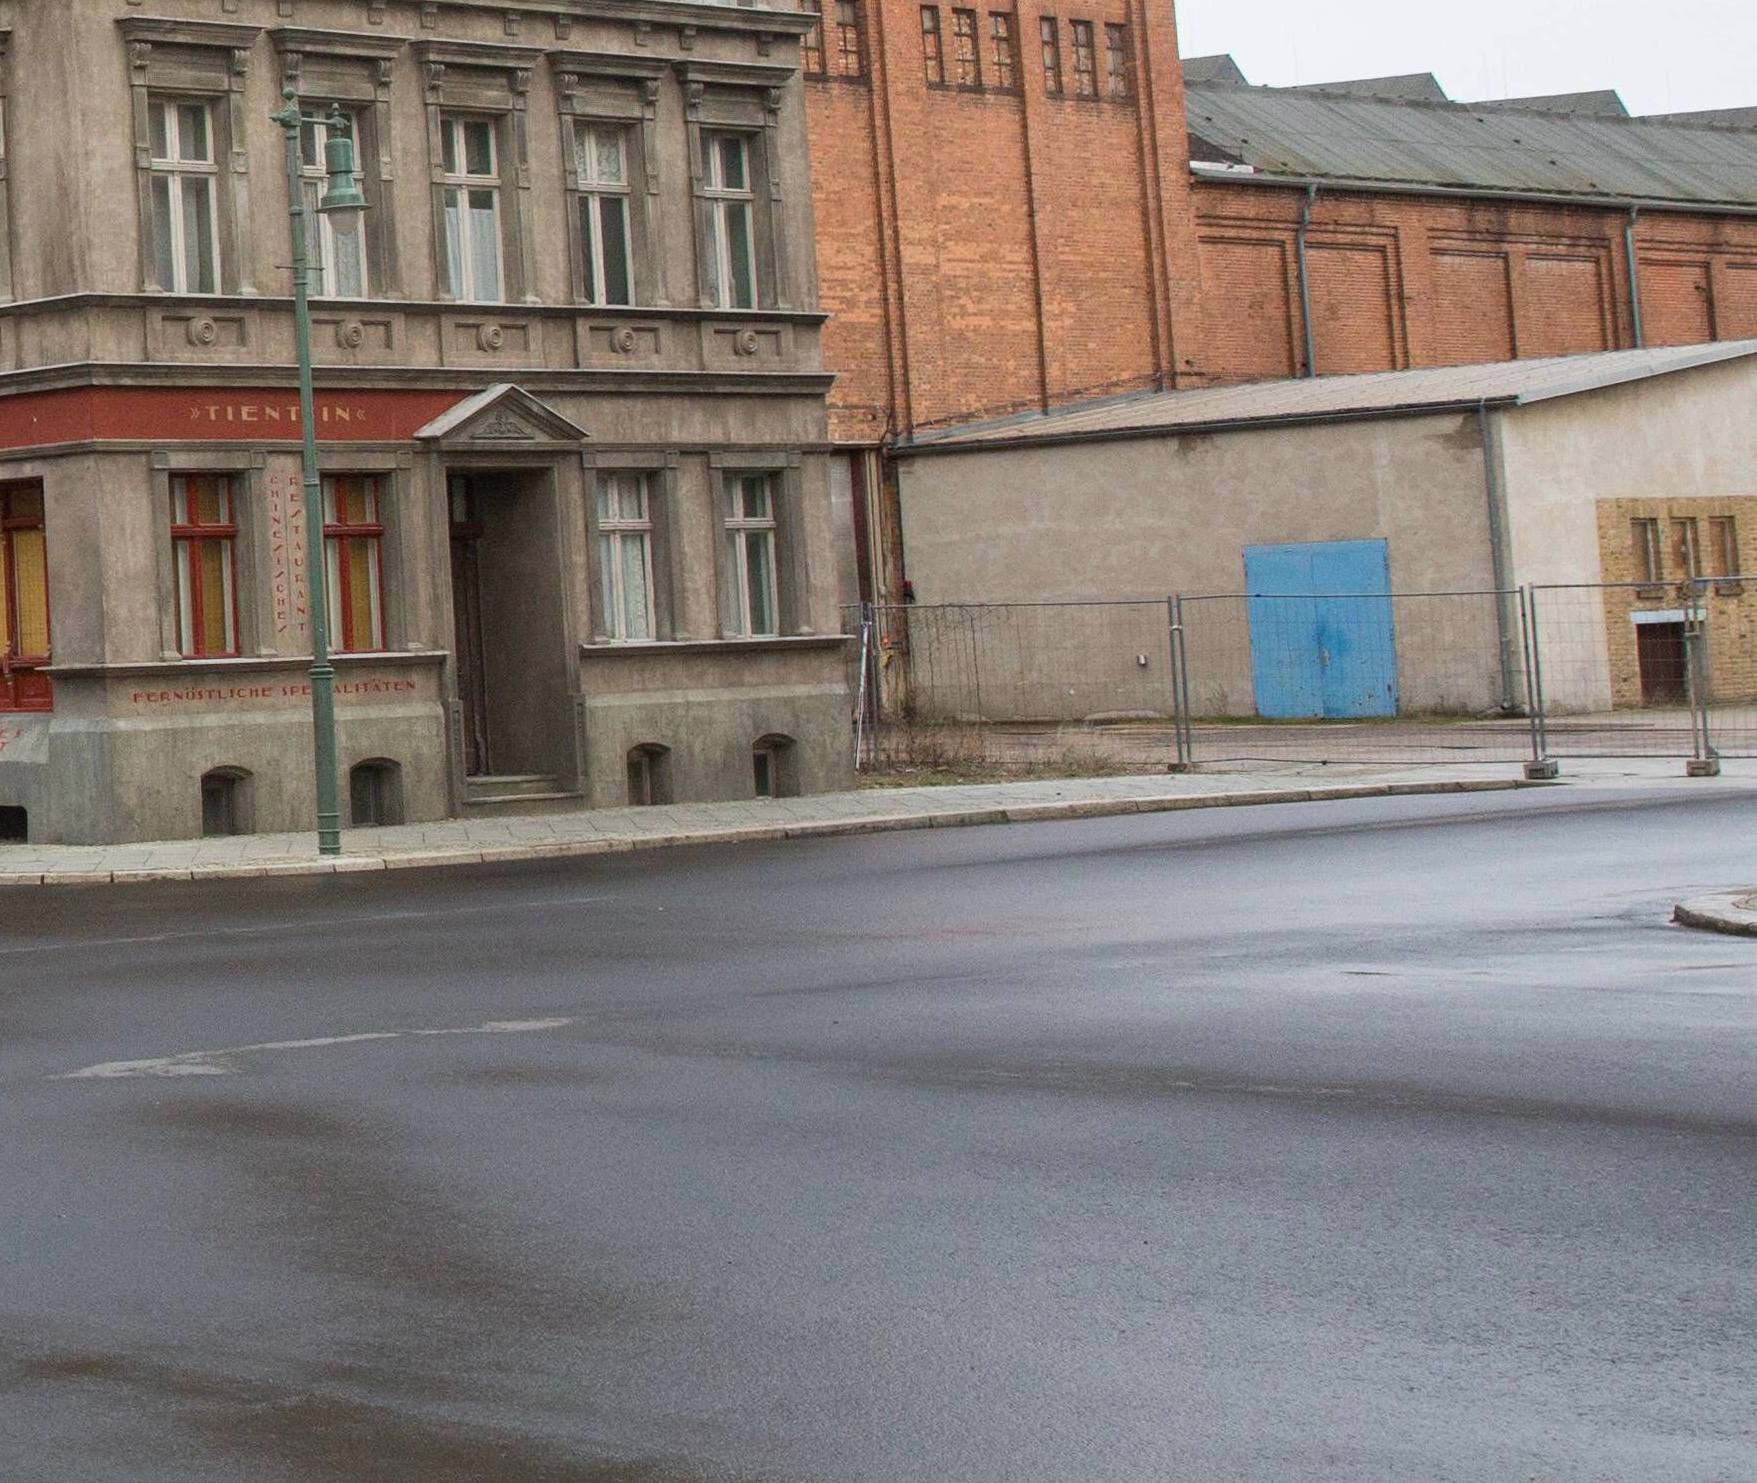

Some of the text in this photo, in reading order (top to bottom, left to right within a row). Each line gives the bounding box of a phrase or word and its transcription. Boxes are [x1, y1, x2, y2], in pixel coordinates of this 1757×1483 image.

[190, 405, 366, 422] »TIENTIN«
[270, 476, 287, 633] CHINESISCHES
[289, 477, 305, 632] RESTAURANT
[133, 678, 416, 703] FERNÖSTLICHE SPEALITÄTEN
